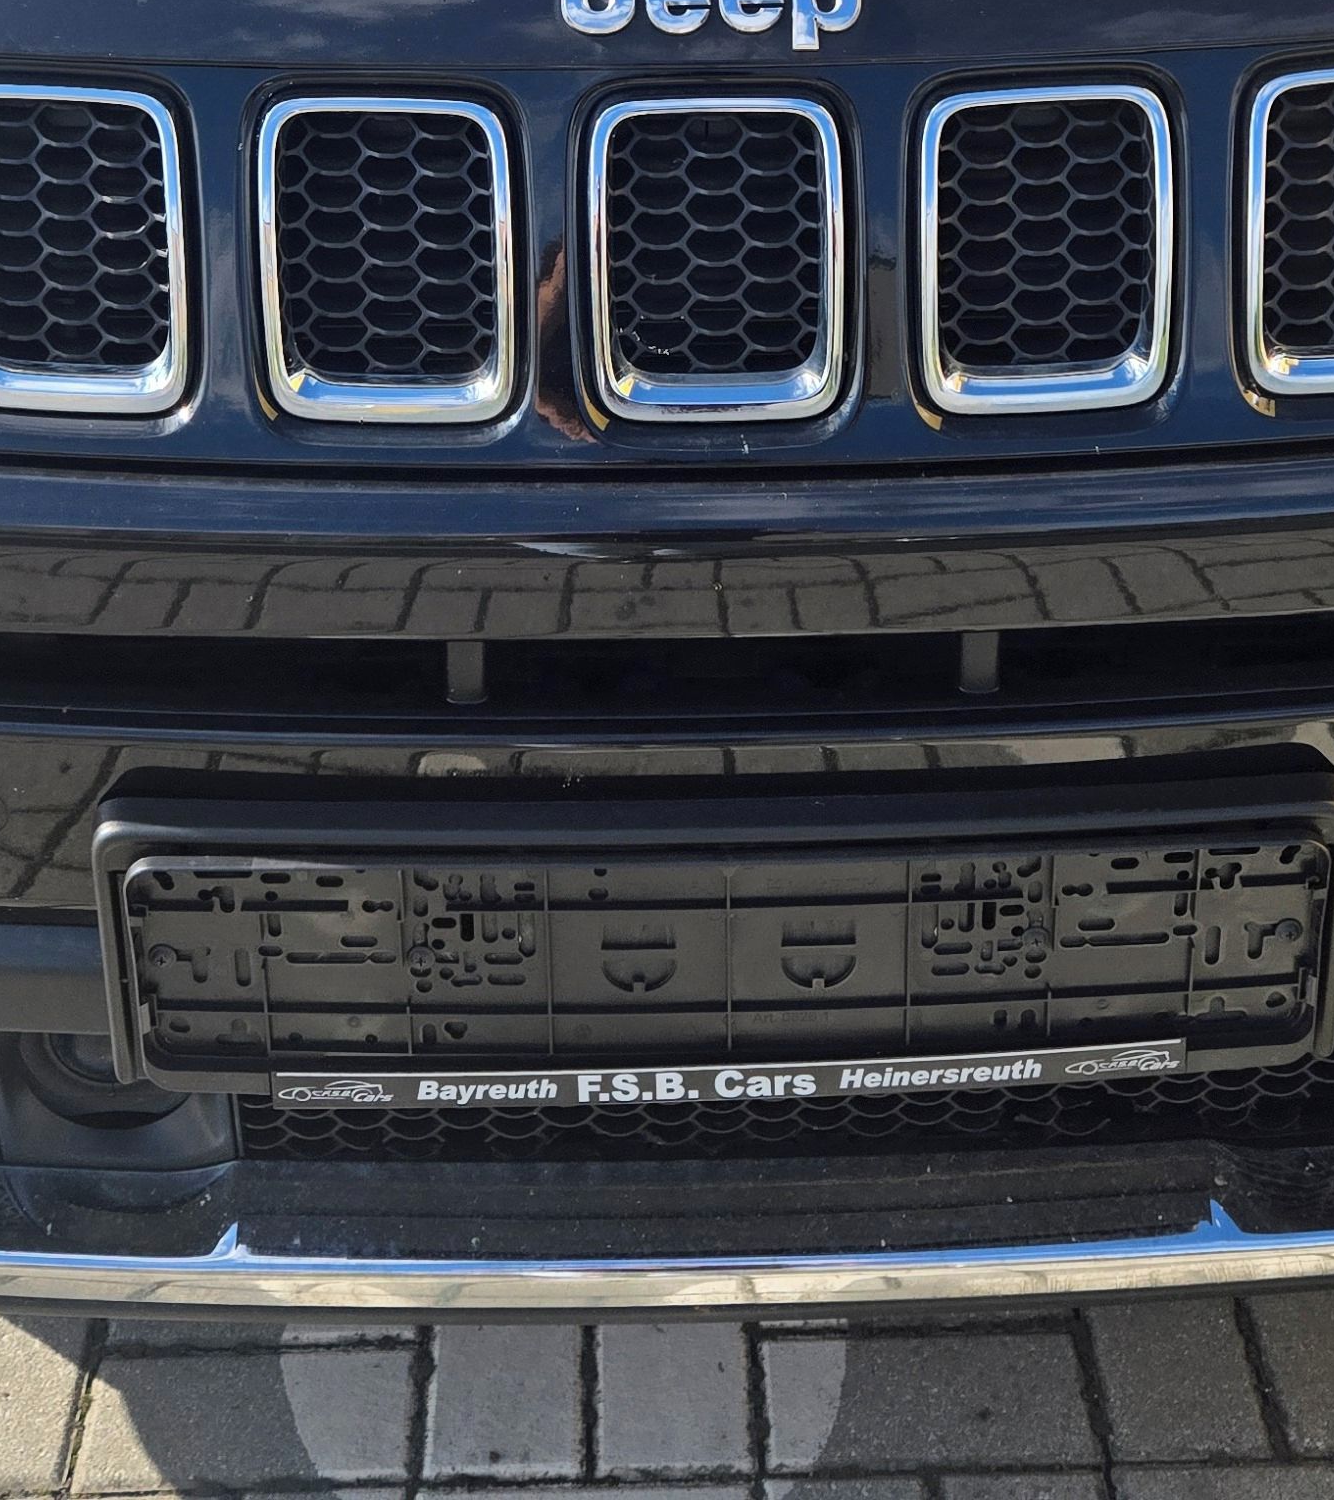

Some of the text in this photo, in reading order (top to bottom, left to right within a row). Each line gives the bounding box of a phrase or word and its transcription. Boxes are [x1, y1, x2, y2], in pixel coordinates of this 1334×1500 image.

[1139, 1060, 1180, 1071] Cars
[417, 1059, 1042, 1104] Bayreuth F.S.B. Cars Heinersreuth
[353, 1092, 394, 1102] Cars
